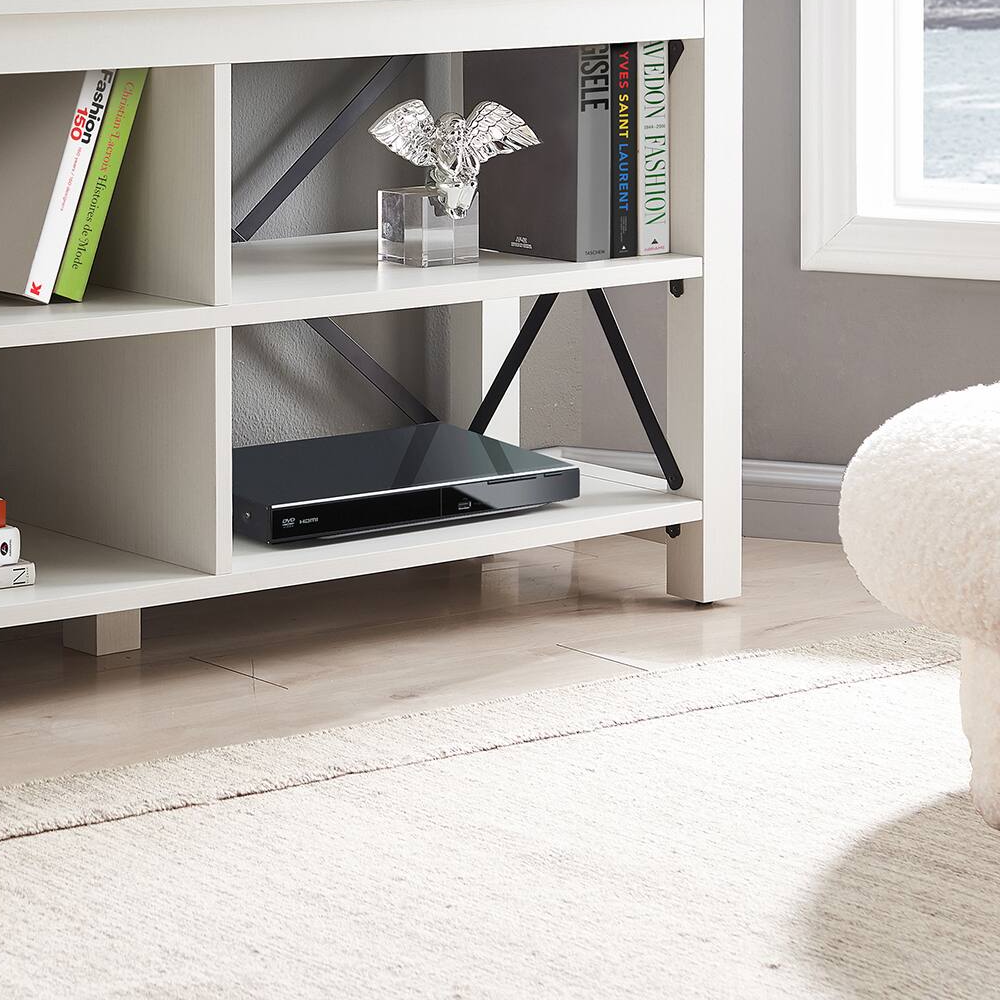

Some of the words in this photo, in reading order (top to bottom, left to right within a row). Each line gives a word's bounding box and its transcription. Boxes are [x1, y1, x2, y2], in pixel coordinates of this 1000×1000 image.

[619, 51, 629, 89] YVES
[70, 107, 89, 141] 150
[81, 69, 114, 144] Fashion
[111, 80, 136, 131] Christian
[619, 94, 629, 138] SAINT
[86, 174, 108, 222] Histoires
[619, 143, 629, 211] LAURENT
[644, 135, 667, 225] FASHION
[81, 223, 93, 237] de
[71, 237, 89, 270] Mode
[30, 281, 42, 296] K
